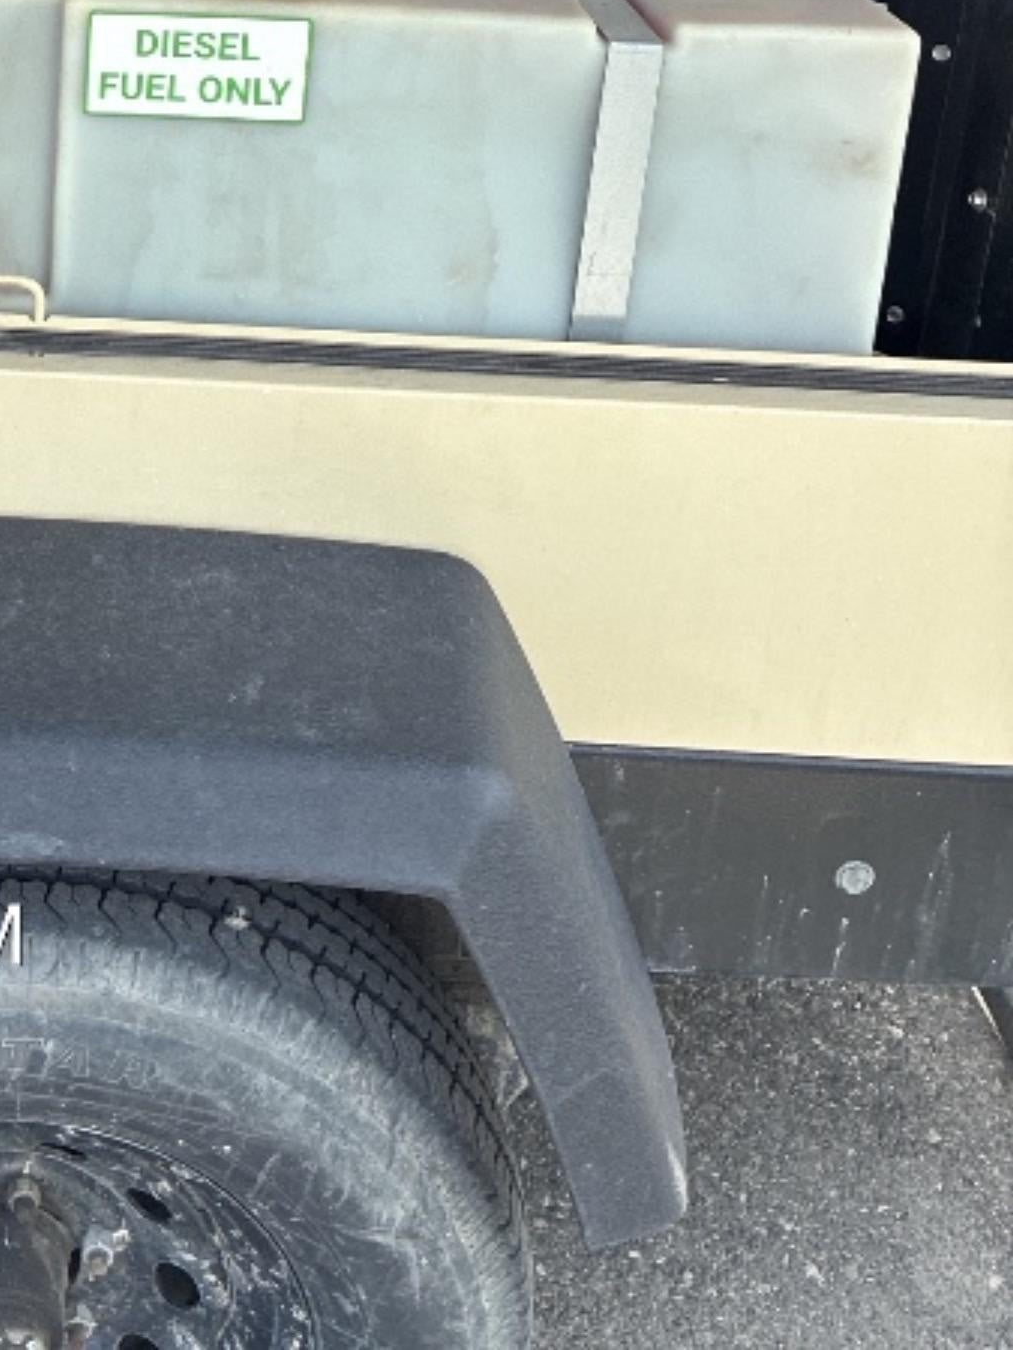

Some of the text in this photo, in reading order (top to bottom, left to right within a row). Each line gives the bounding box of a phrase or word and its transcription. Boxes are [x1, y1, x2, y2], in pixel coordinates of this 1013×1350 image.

[136, 29, 261, 61] DIESEL
[99, 71, 292, 106] FUEL ONLY
